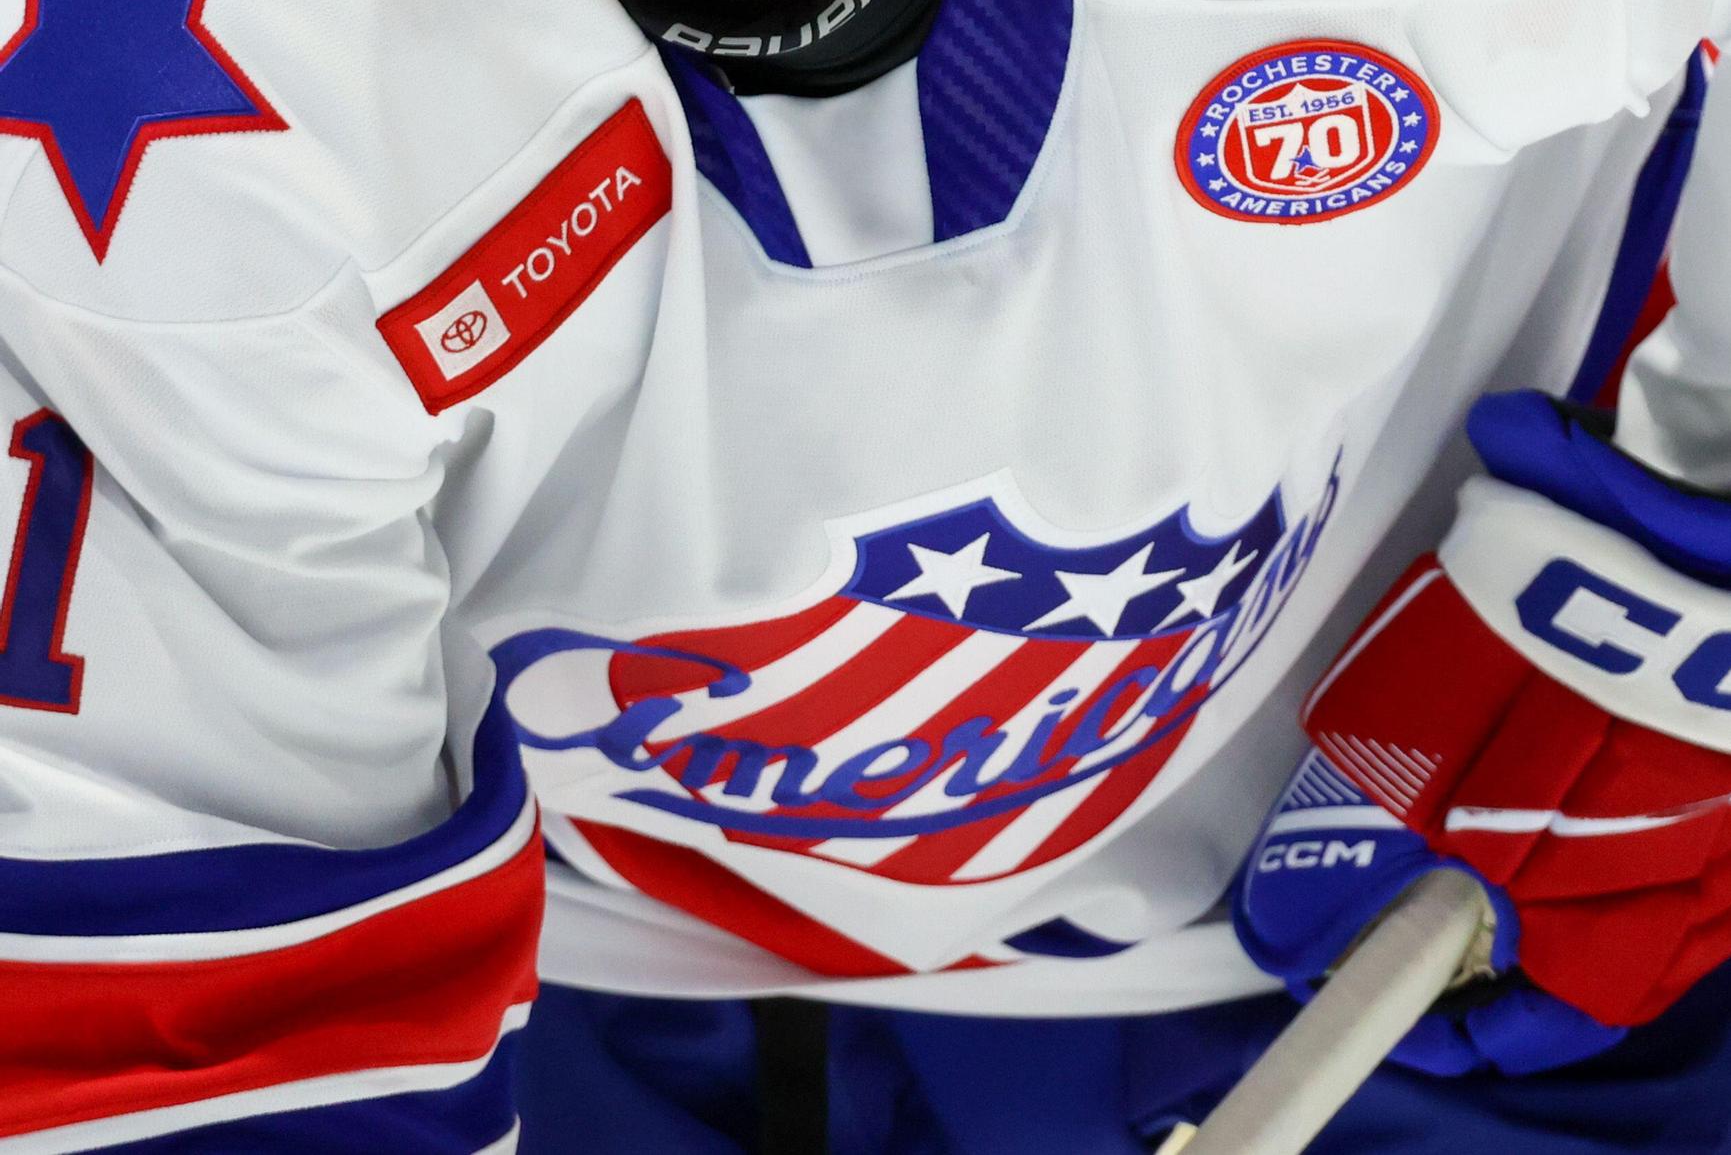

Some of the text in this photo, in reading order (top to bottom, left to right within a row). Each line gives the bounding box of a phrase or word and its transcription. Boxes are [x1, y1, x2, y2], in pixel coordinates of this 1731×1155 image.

[1208, 55, 1396, 121] ROCHESTER
[1249, 92, 1355, 123] EST. 1956
[1254, 114, 1361, 181] 70
[1221, 160, 1406, 216] AMERICANS
[502, 166, 642, 298] TOYOTA
[1258, 839, 1376, 873] CCM
